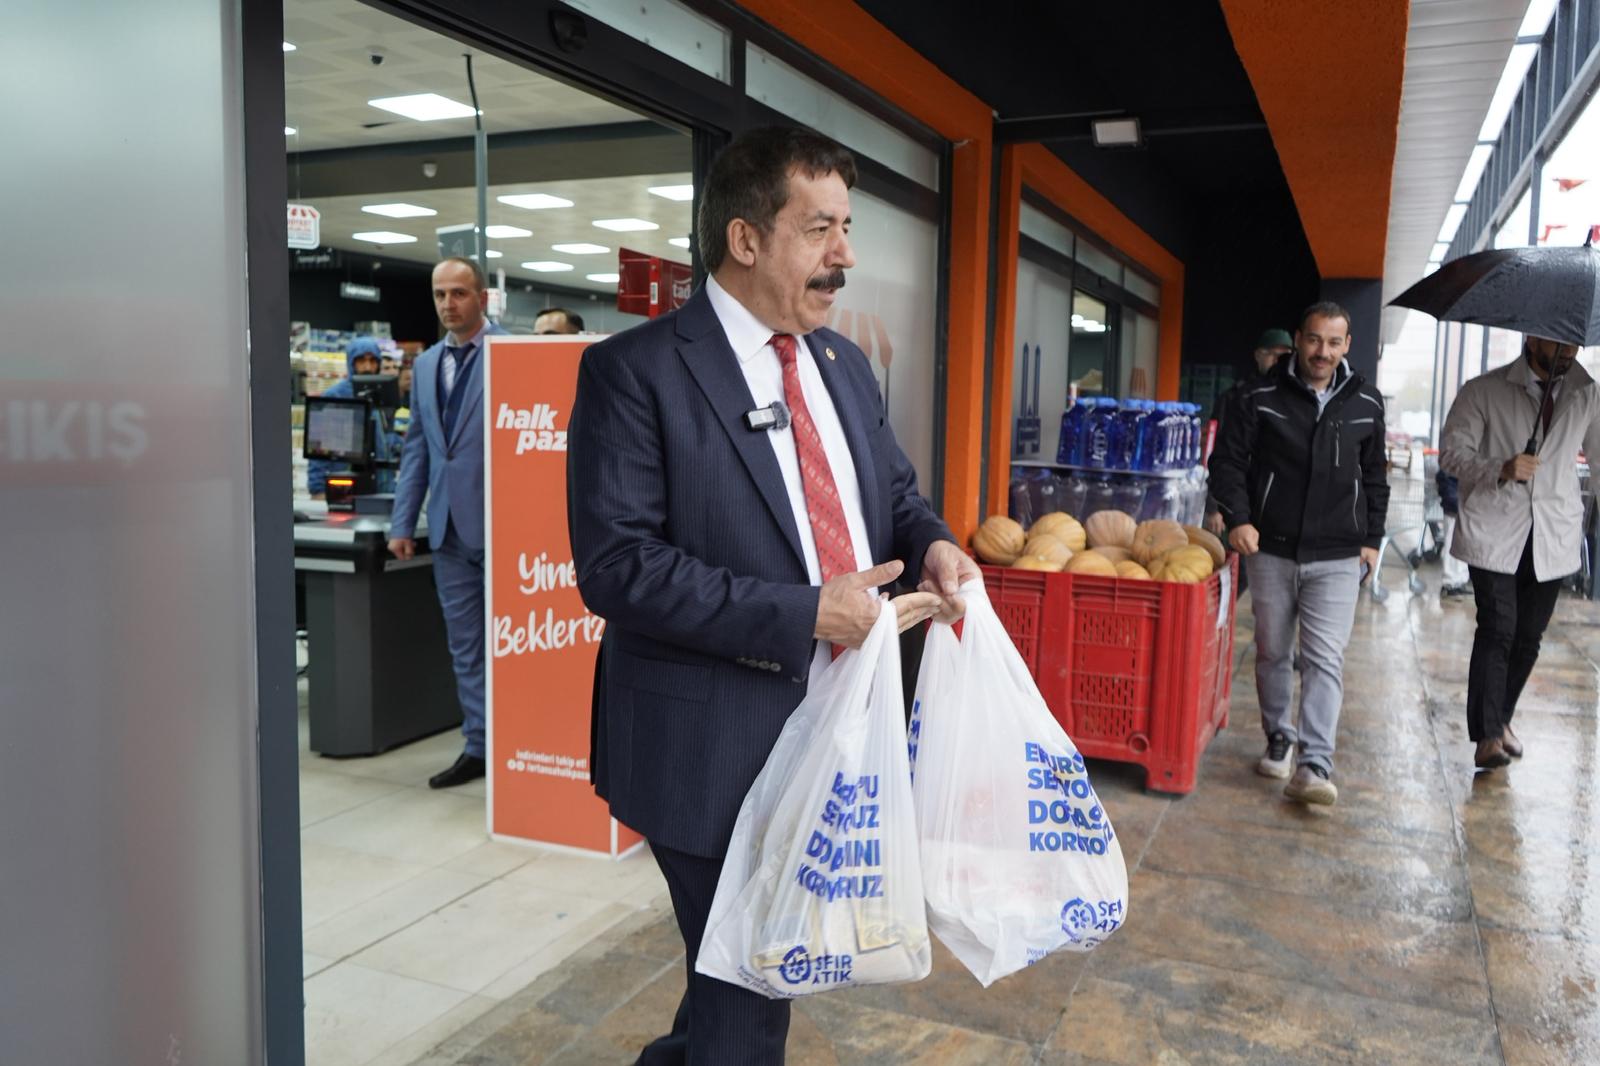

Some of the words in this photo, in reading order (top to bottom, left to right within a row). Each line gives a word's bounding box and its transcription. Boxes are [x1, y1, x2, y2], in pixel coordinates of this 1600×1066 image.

[672, 283, 692, 300] tad
[496, 403, 558, 430] halk
[0, 399, 148, 466] IKIŞ
[516, 429, 569, 455] paz
[518, 551, 578, 595] Yine
[492, 607, 606, 658] Bekleriz
[1095, 919, 1119, 933] AT
